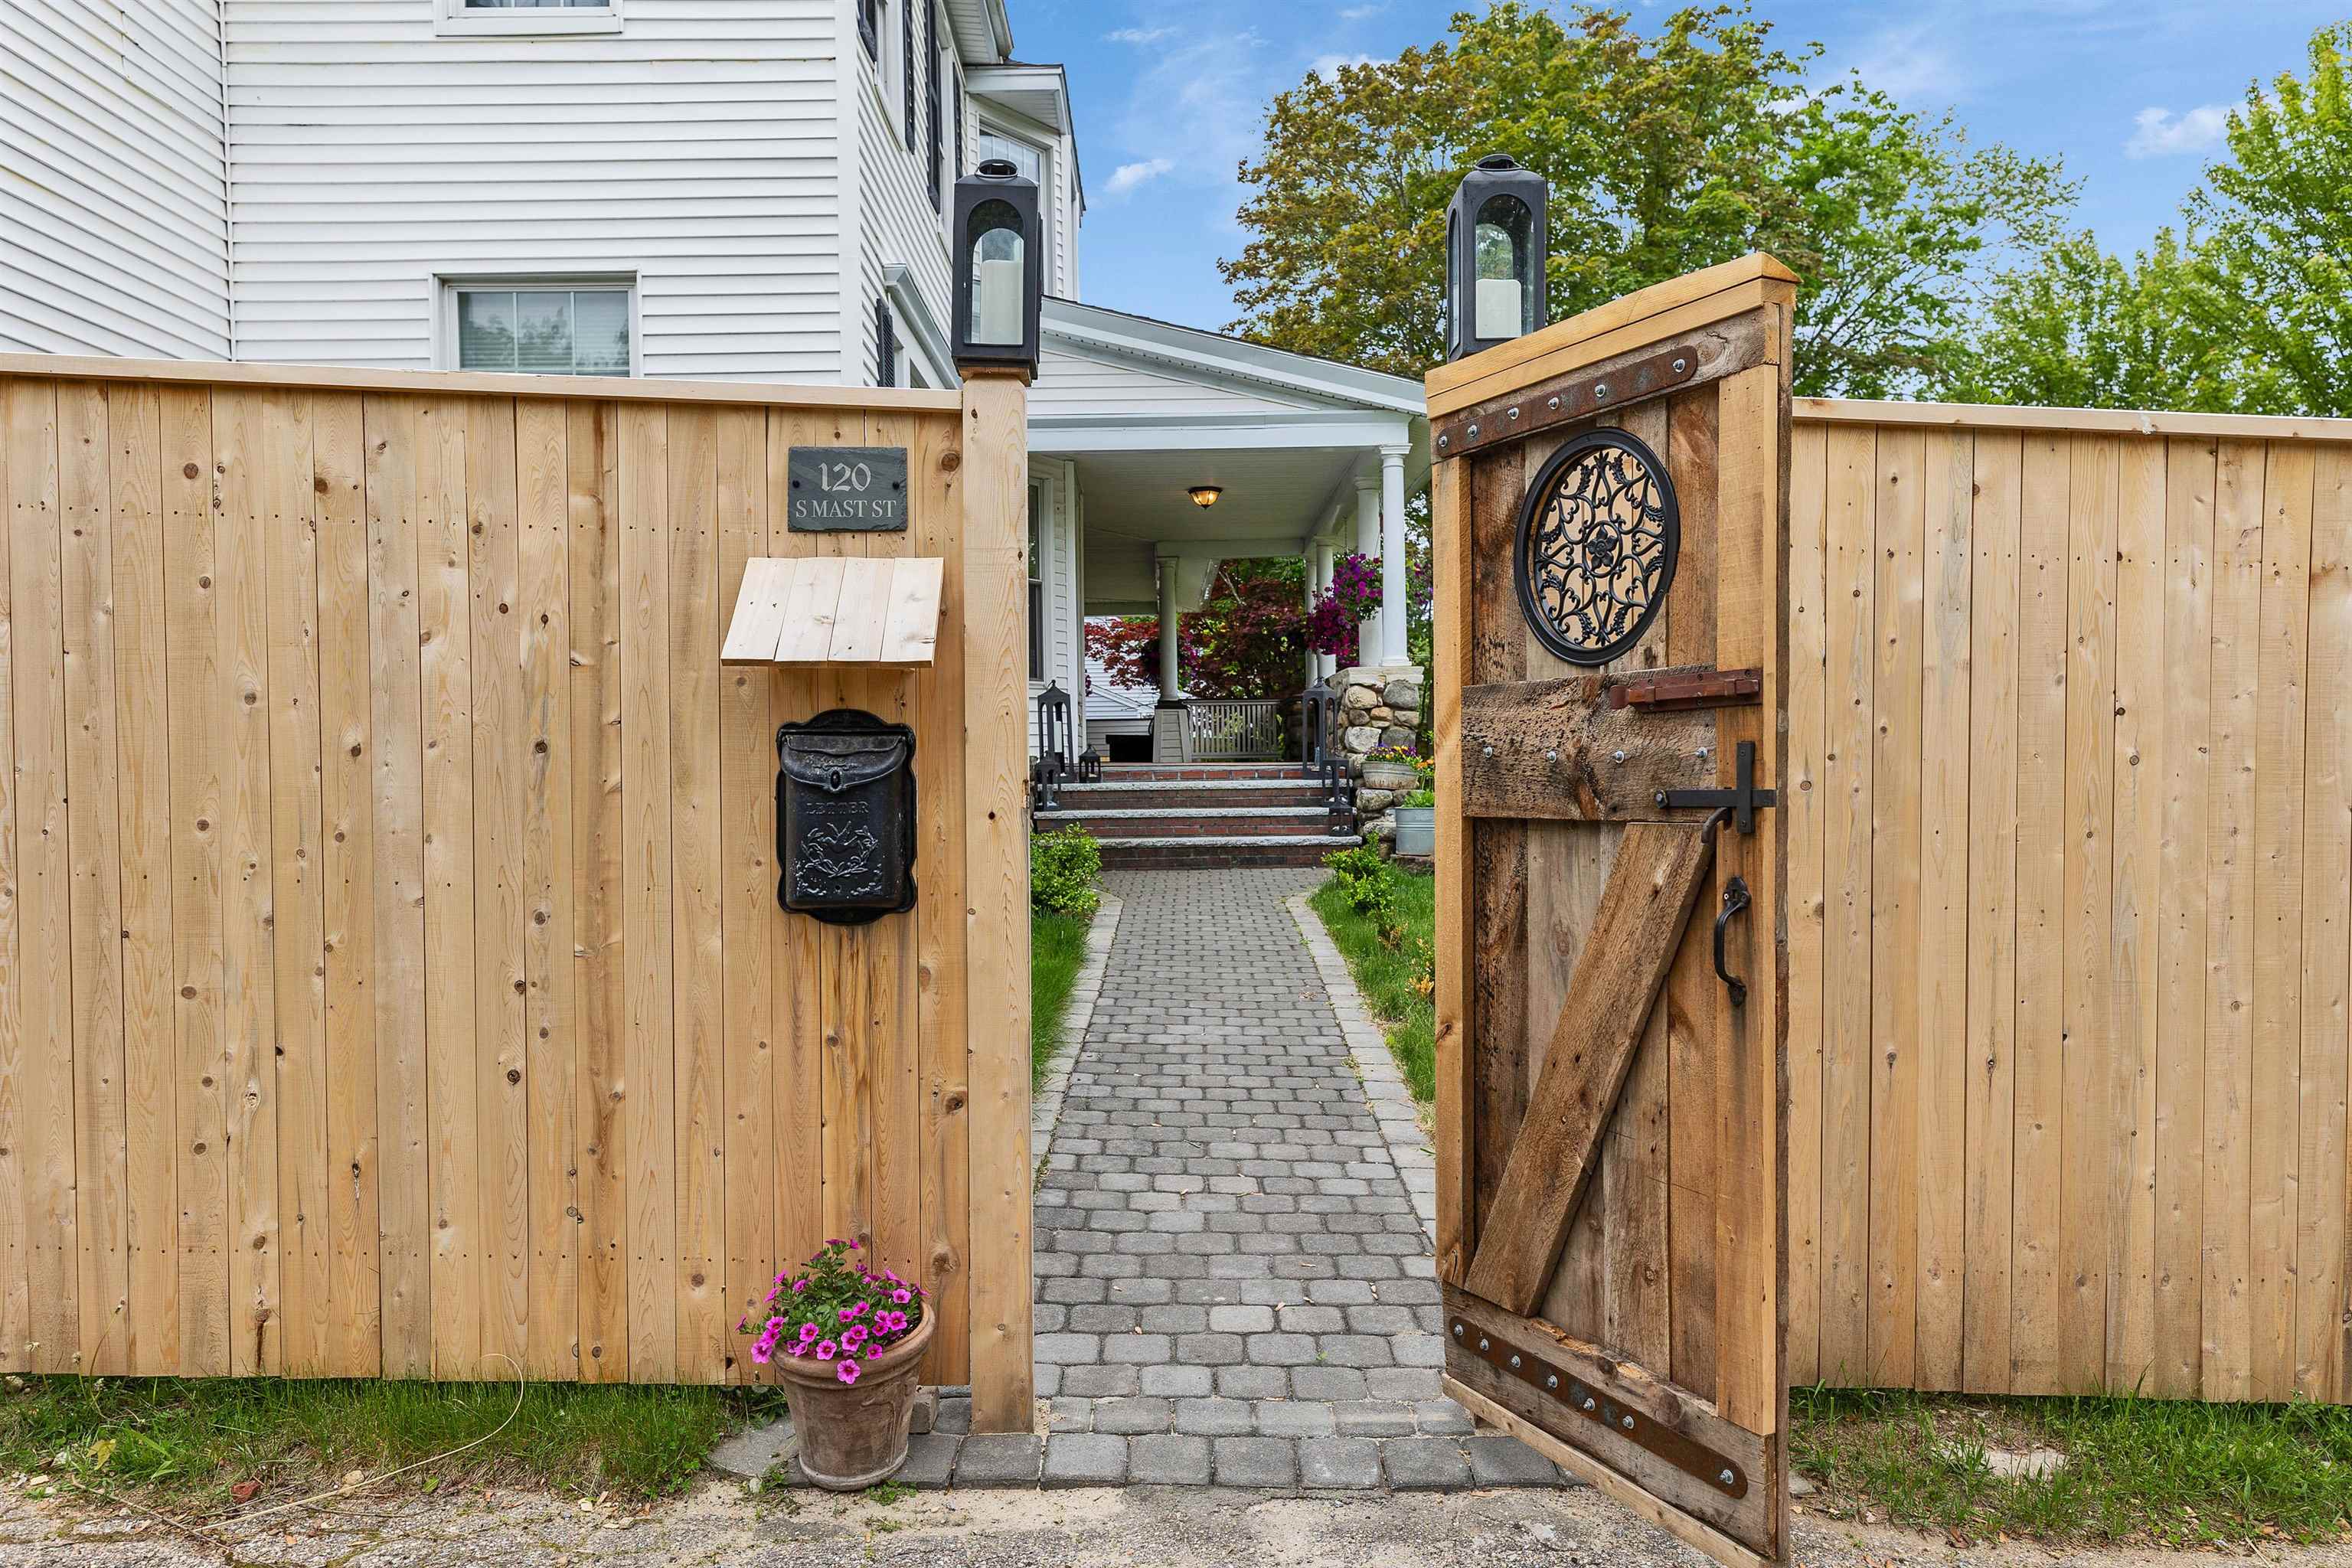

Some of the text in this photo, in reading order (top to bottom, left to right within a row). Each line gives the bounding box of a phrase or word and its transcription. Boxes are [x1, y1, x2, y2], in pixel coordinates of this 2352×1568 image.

[818, 462, 871, 492] 120
[795, 500, 897, 518] S MAST ST
